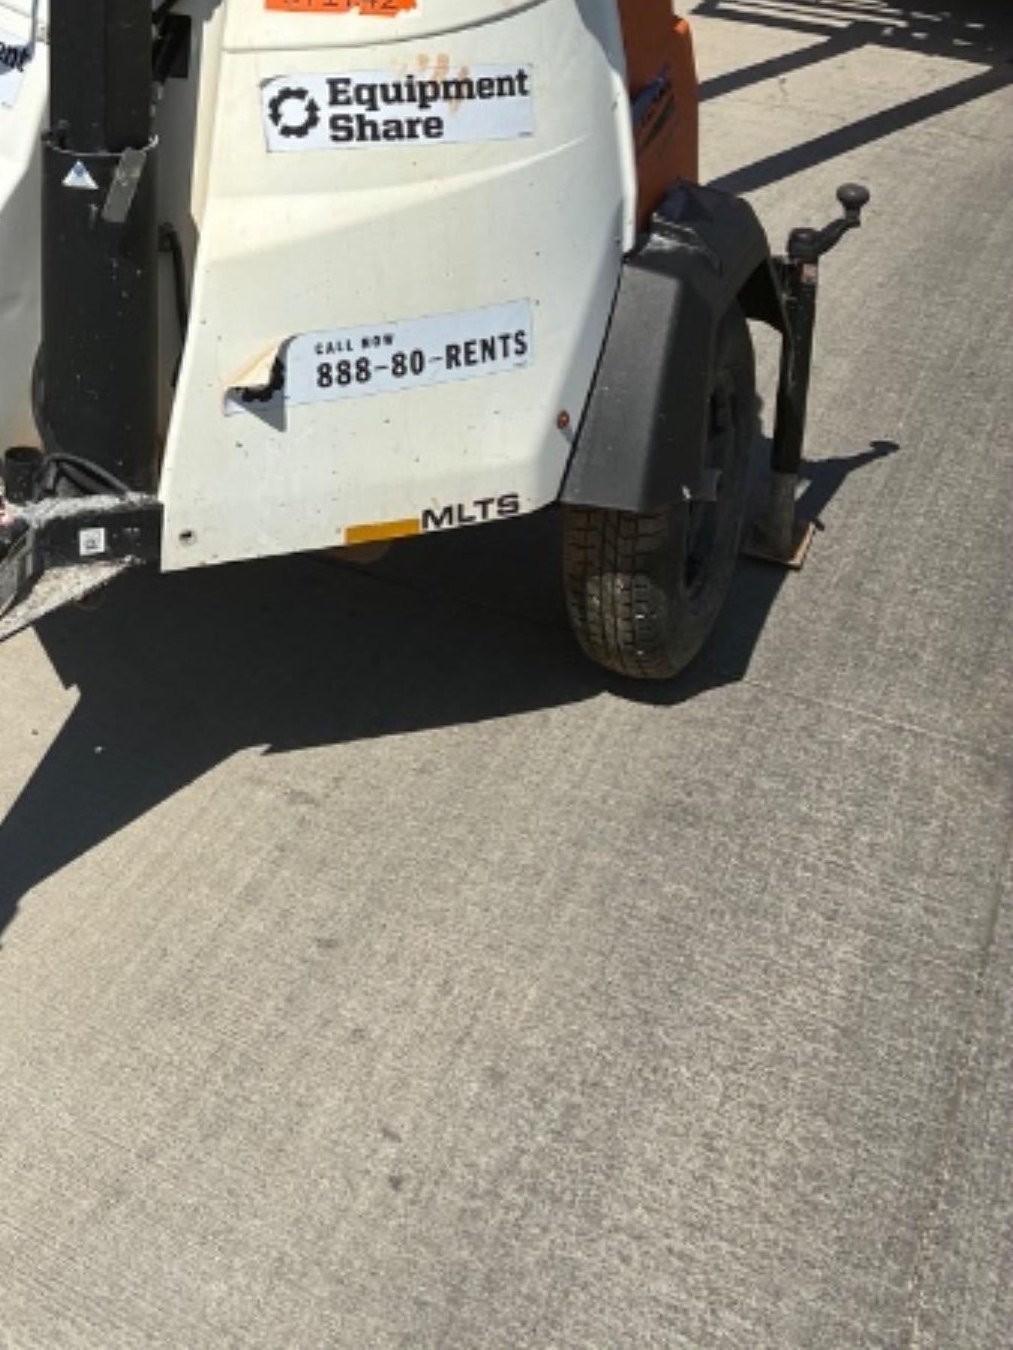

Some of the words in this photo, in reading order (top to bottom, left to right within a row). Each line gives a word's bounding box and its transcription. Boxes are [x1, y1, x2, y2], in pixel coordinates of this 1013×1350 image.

[325, 68, 530, 111] Equipment
[329, 113, 444, 142] Share
[314, 338, 354, 355] CALL
[361, 333, 395, 350] NOW
[316, 330, 528, 389] 888-80-RENTS
[421, 493, 520, 530] MLTS
